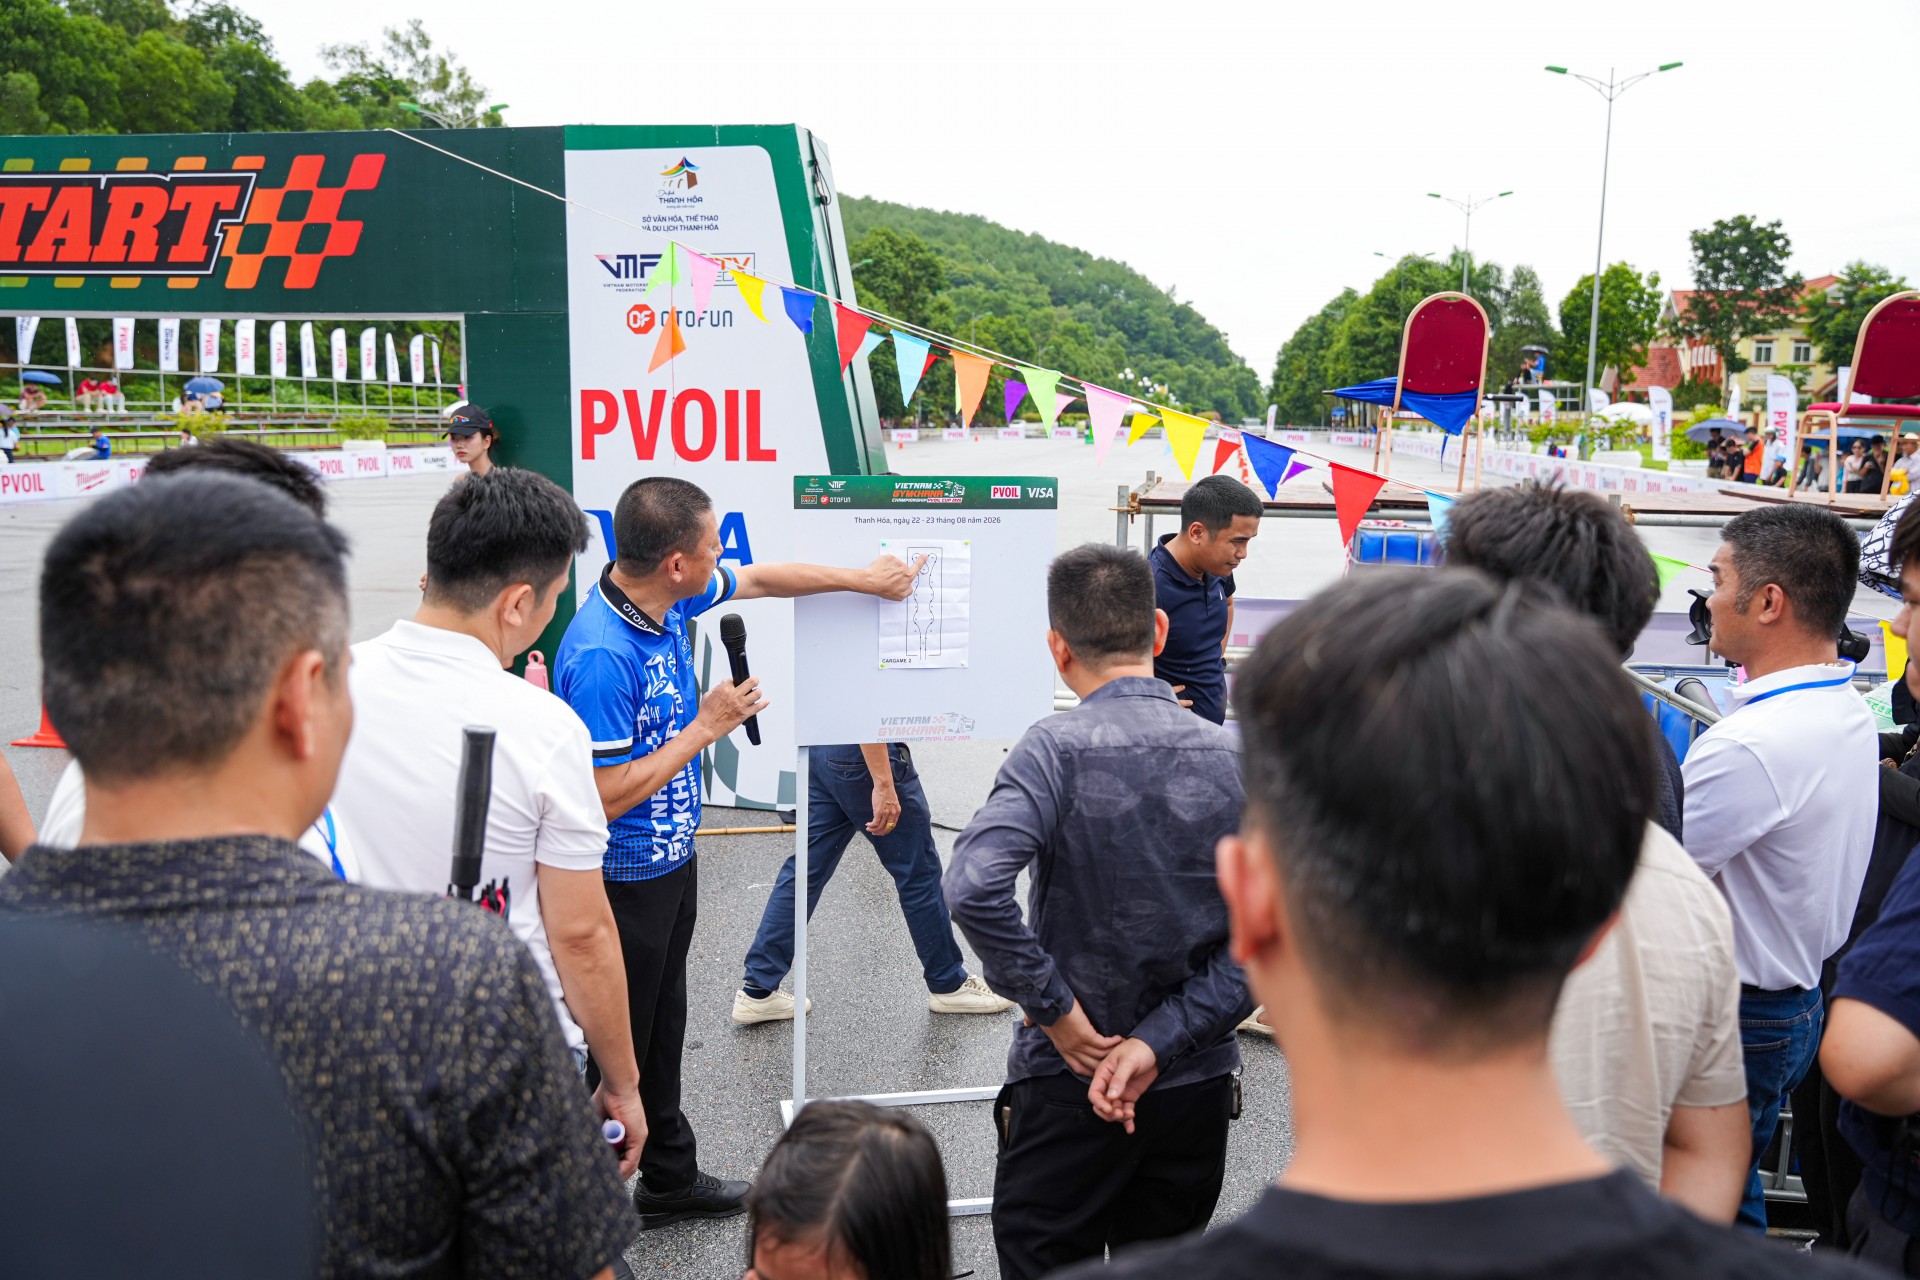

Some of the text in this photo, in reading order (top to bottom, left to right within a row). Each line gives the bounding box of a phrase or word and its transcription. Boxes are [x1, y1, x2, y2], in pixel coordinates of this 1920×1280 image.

[580, 388, 777, 462] PVOIL
[320, 459, 344, 475] PVOIL
[358, 457, 380, 472] PVOIL
[393, 455, 414, 470] PVOIL
[1, 472, 44, 494] PVOIL
[892, 490, 944, 498] GYMKHANA
[993, 486, 1018, 498] PVOIL
[1026, 487, 1054, 498] VISA
[876, 516, 892, 524] Hóa,
[893, 516, 910, 525] ngày
[936, 516, 956, 525] tháng
[880, 716, 932, 726] VIETNAM
[878, 726, 946, 736] GYMKHANA
